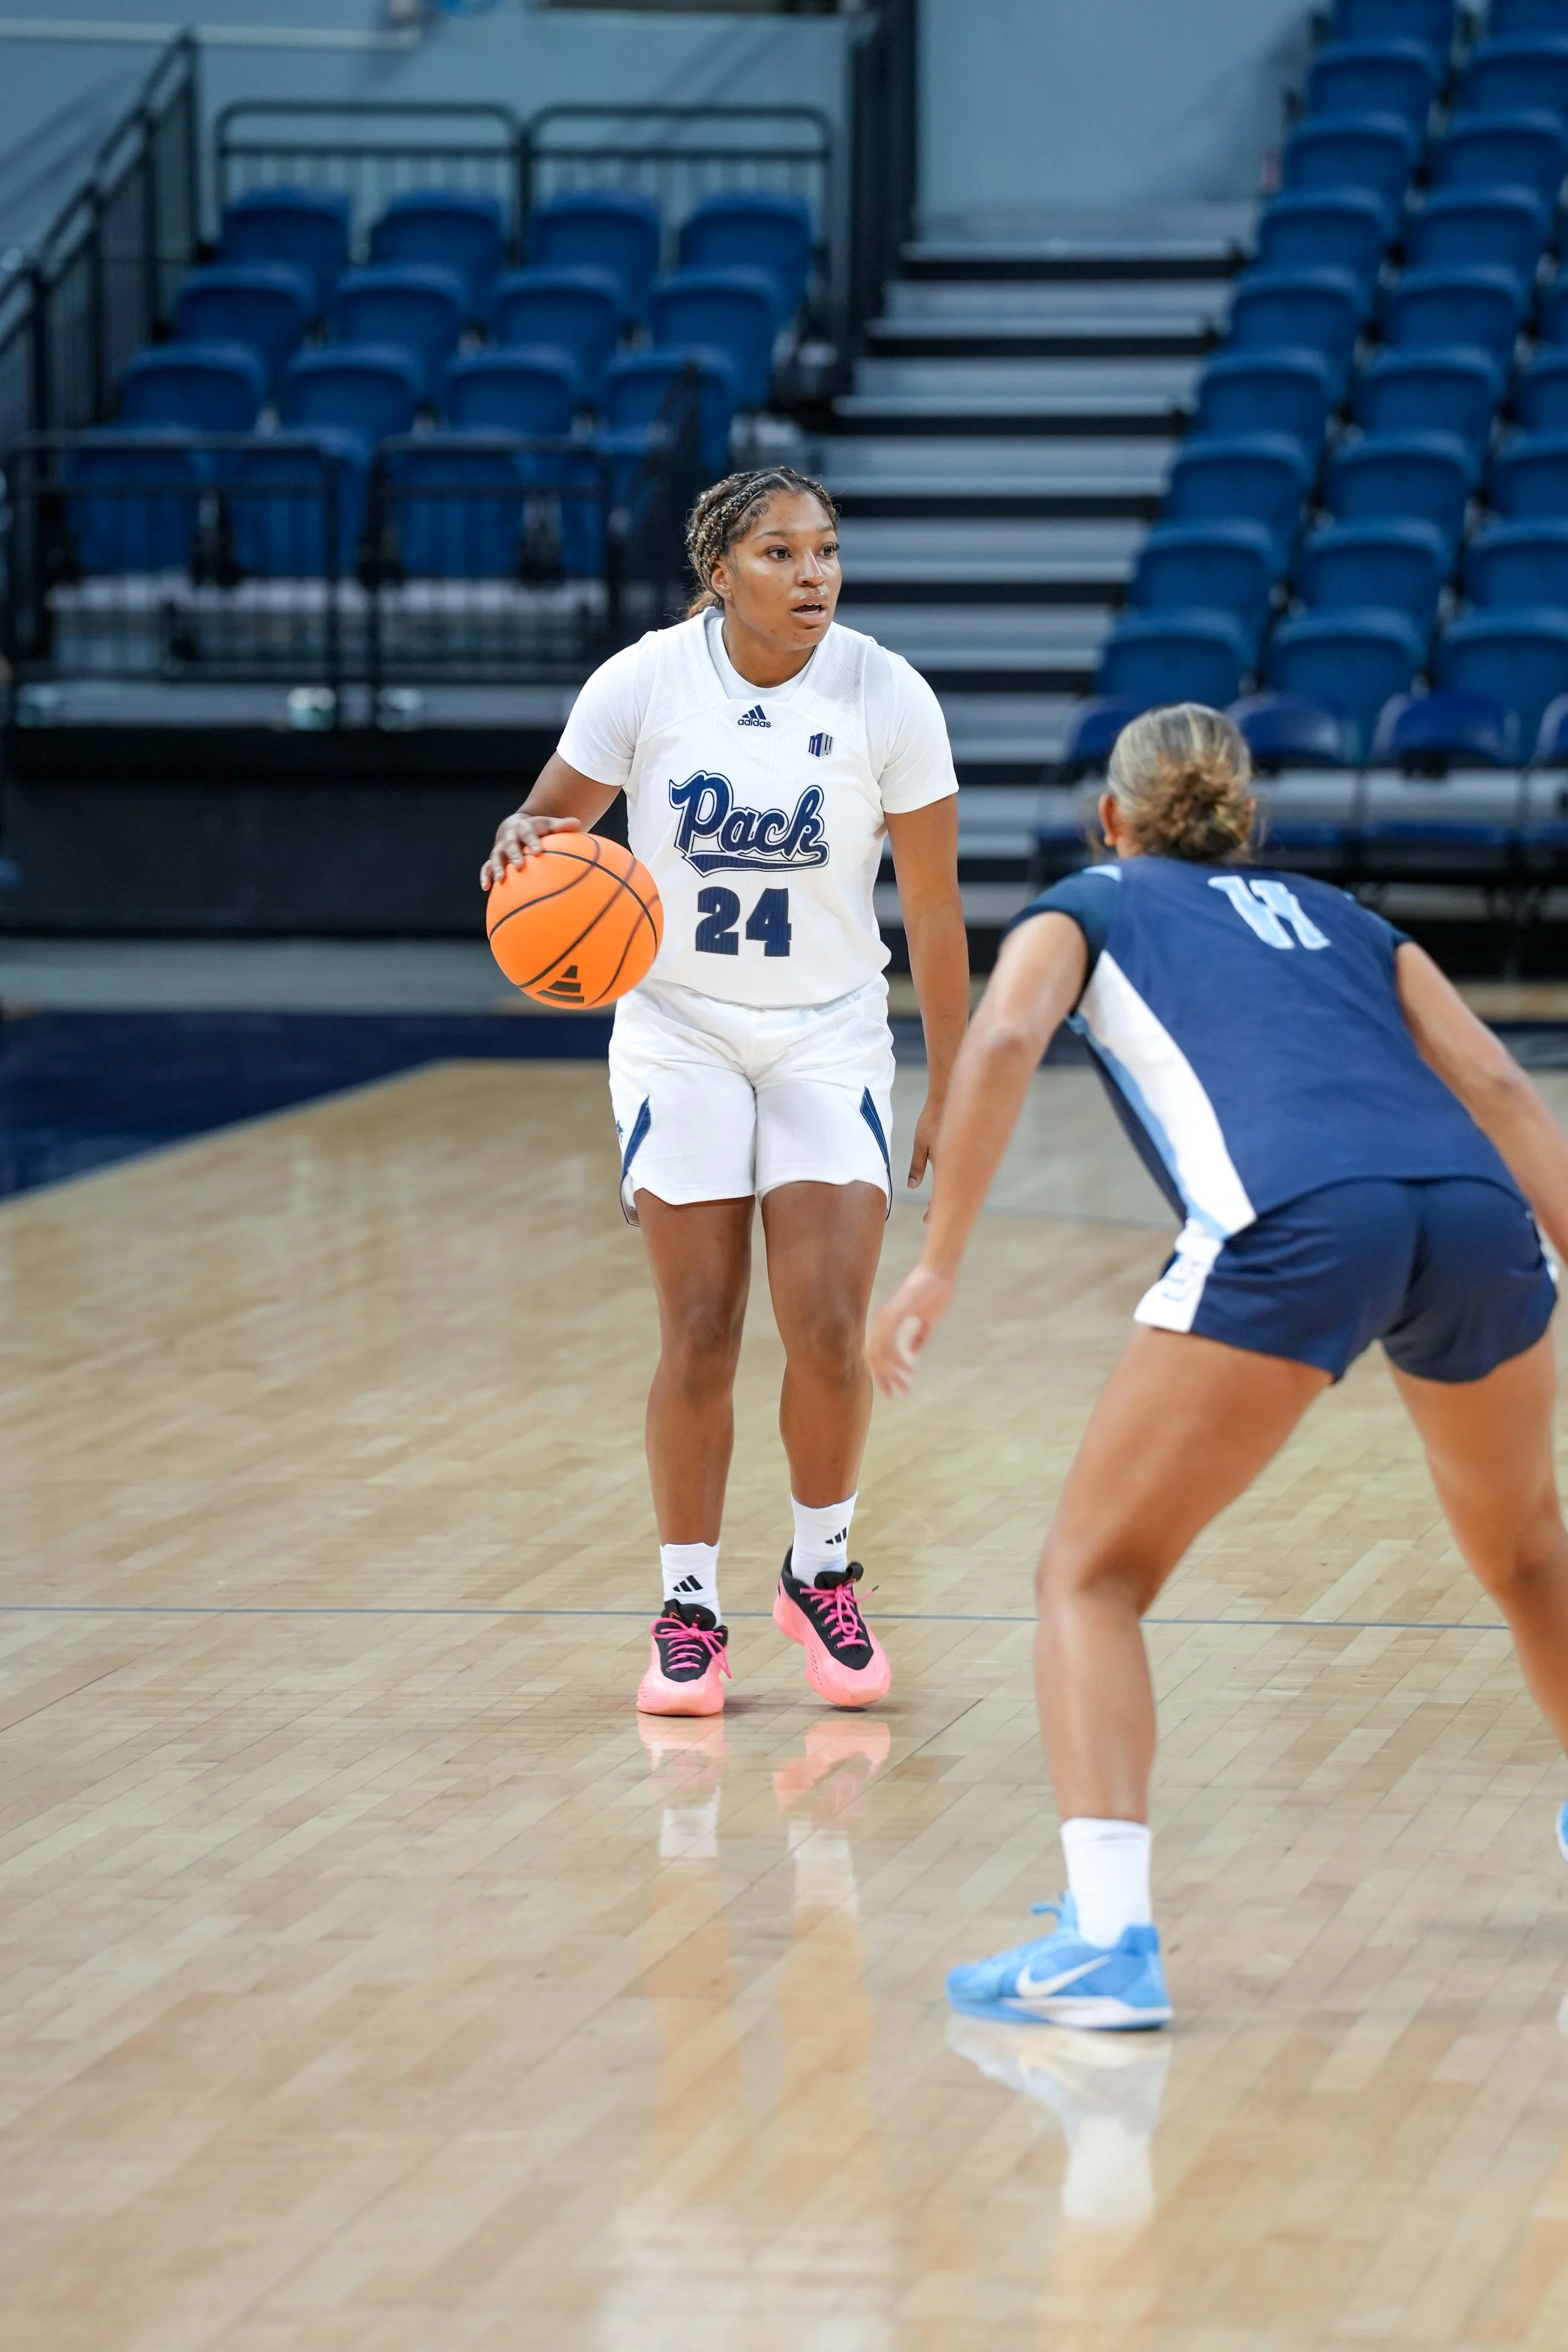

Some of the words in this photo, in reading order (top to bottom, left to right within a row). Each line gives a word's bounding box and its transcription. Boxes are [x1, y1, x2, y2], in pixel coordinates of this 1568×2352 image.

[738, 718, 771, 728] adidas
[669, 770, 830, 872] Pack
[695, 886, 792, 957] 24
